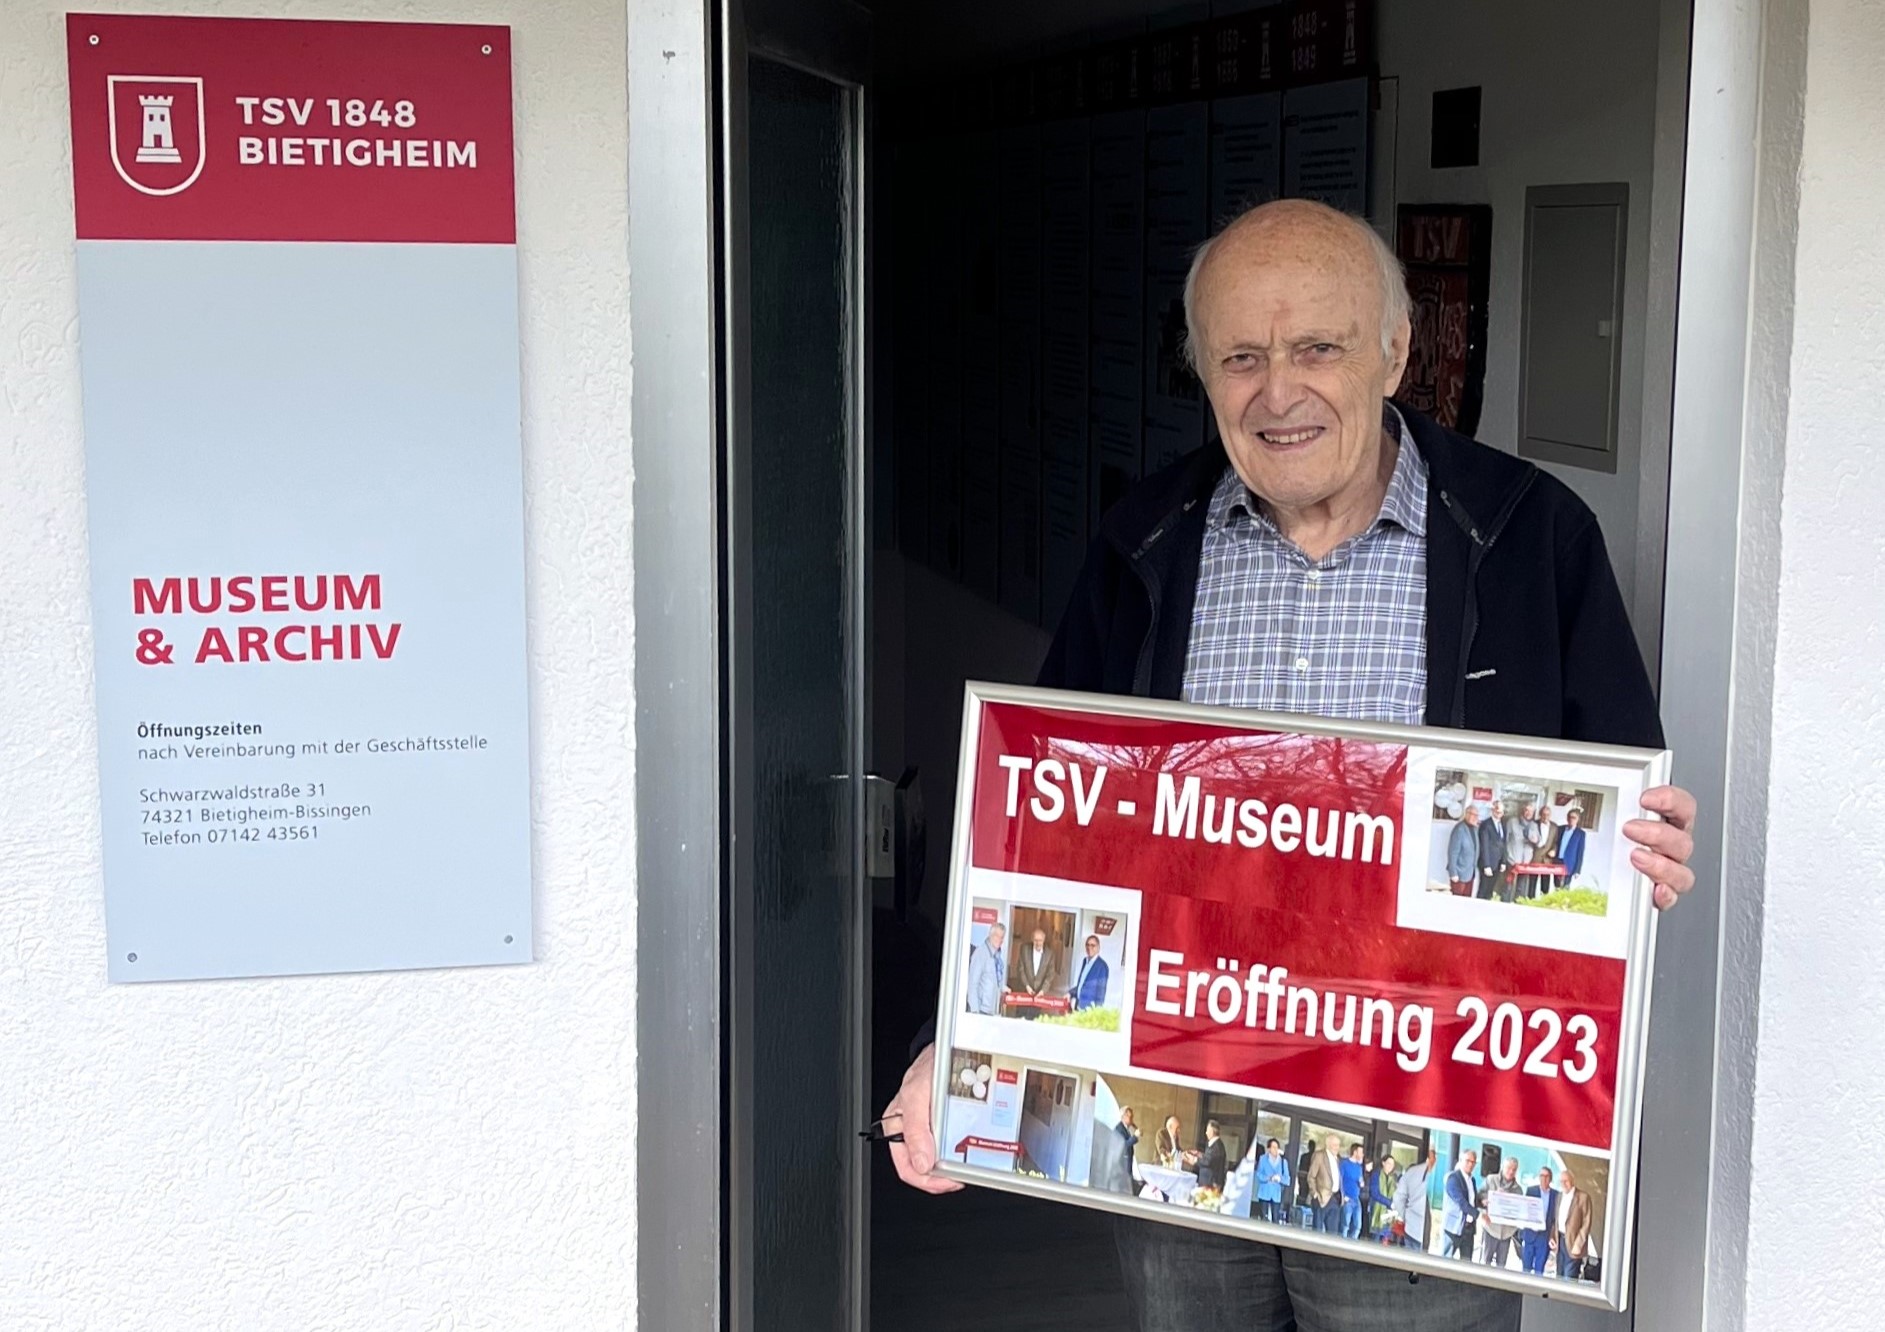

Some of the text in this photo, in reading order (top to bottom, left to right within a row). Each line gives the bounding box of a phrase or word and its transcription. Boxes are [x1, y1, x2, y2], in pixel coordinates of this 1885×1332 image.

[236, 97, 416, 128] TSV 1848
[238, 136, 477, 168] BIETIGHEIM
[1411, 216, 1462, 262] TSV
[133, 574, 381, 615] MUSEUM
[135, 623, 402, 665] & ARCHIV
[137, 720, 263, 740] Öffnungszeiten
[138, 735, 488, 760] nach Vereinbarung mit der Geschäftsstelle
[139, 783, 326, 804] Schwarzwaldstraße 31
[141, 803, 371, 825] 74321 Bietigheim-Bissingen
[999, 754, 1108, 827] TSV
[1152, 772, 1396, 866] Museum
[142, 826, 319, 846] Telefon 07142 43561
[1145, 947, 1599, 1085] Eröffnung 2023
